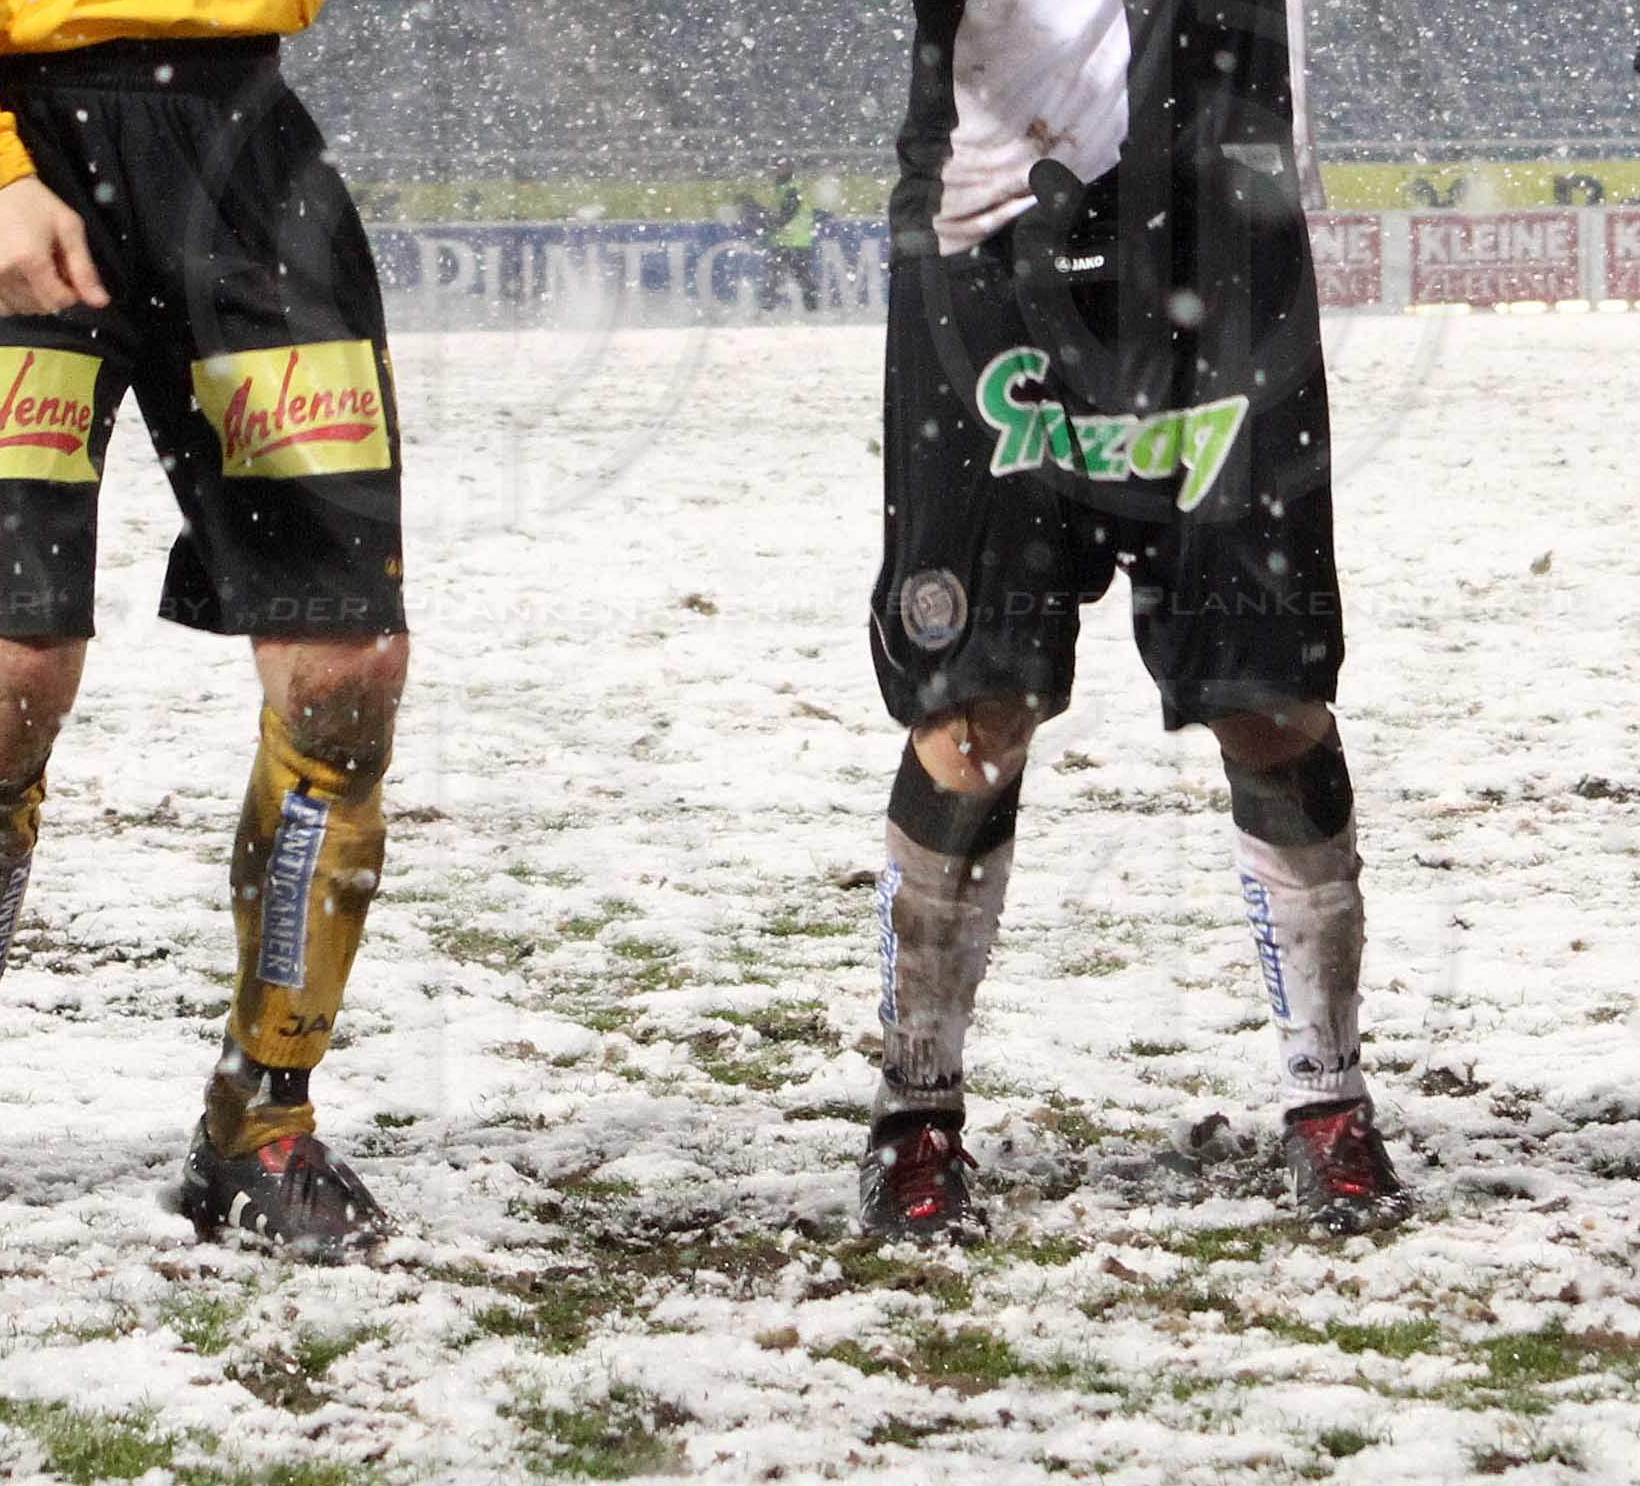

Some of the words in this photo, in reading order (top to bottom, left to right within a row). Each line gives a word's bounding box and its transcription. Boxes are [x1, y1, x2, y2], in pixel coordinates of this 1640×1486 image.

[1420, 222, 1570, 262] KLEINE
[1071, 255, 1105, 272] JAKO
[225, 350, 379, 458] Antenne
